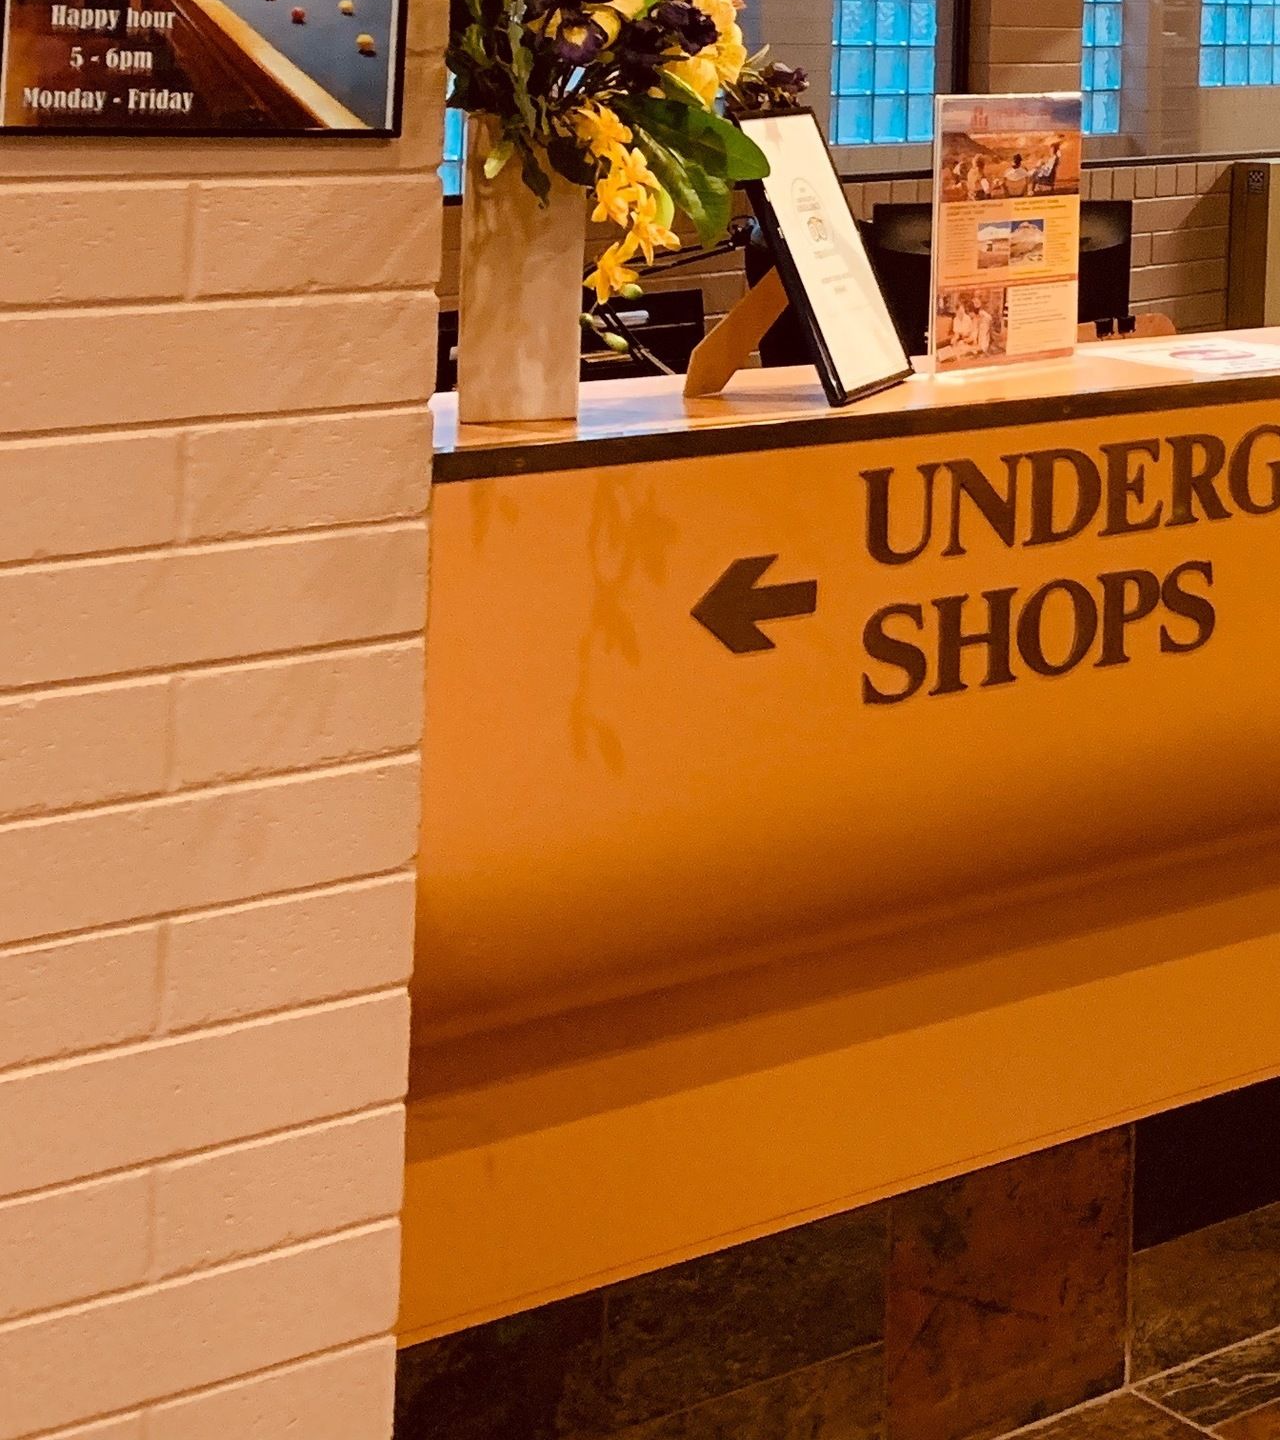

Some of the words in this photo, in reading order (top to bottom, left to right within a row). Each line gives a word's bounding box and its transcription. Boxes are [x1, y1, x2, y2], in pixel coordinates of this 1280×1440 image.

[51, 4, 119, 33] Happy
[127, 5, 175, 30] hour
[70, 47, 83, 70] 5
[105, 47, 153, 73] 6pm
[22, 88, 106, 112] Monday
[127, 88, 194, 112] Friday
[861, 560, 1217, 706] SHOPS
